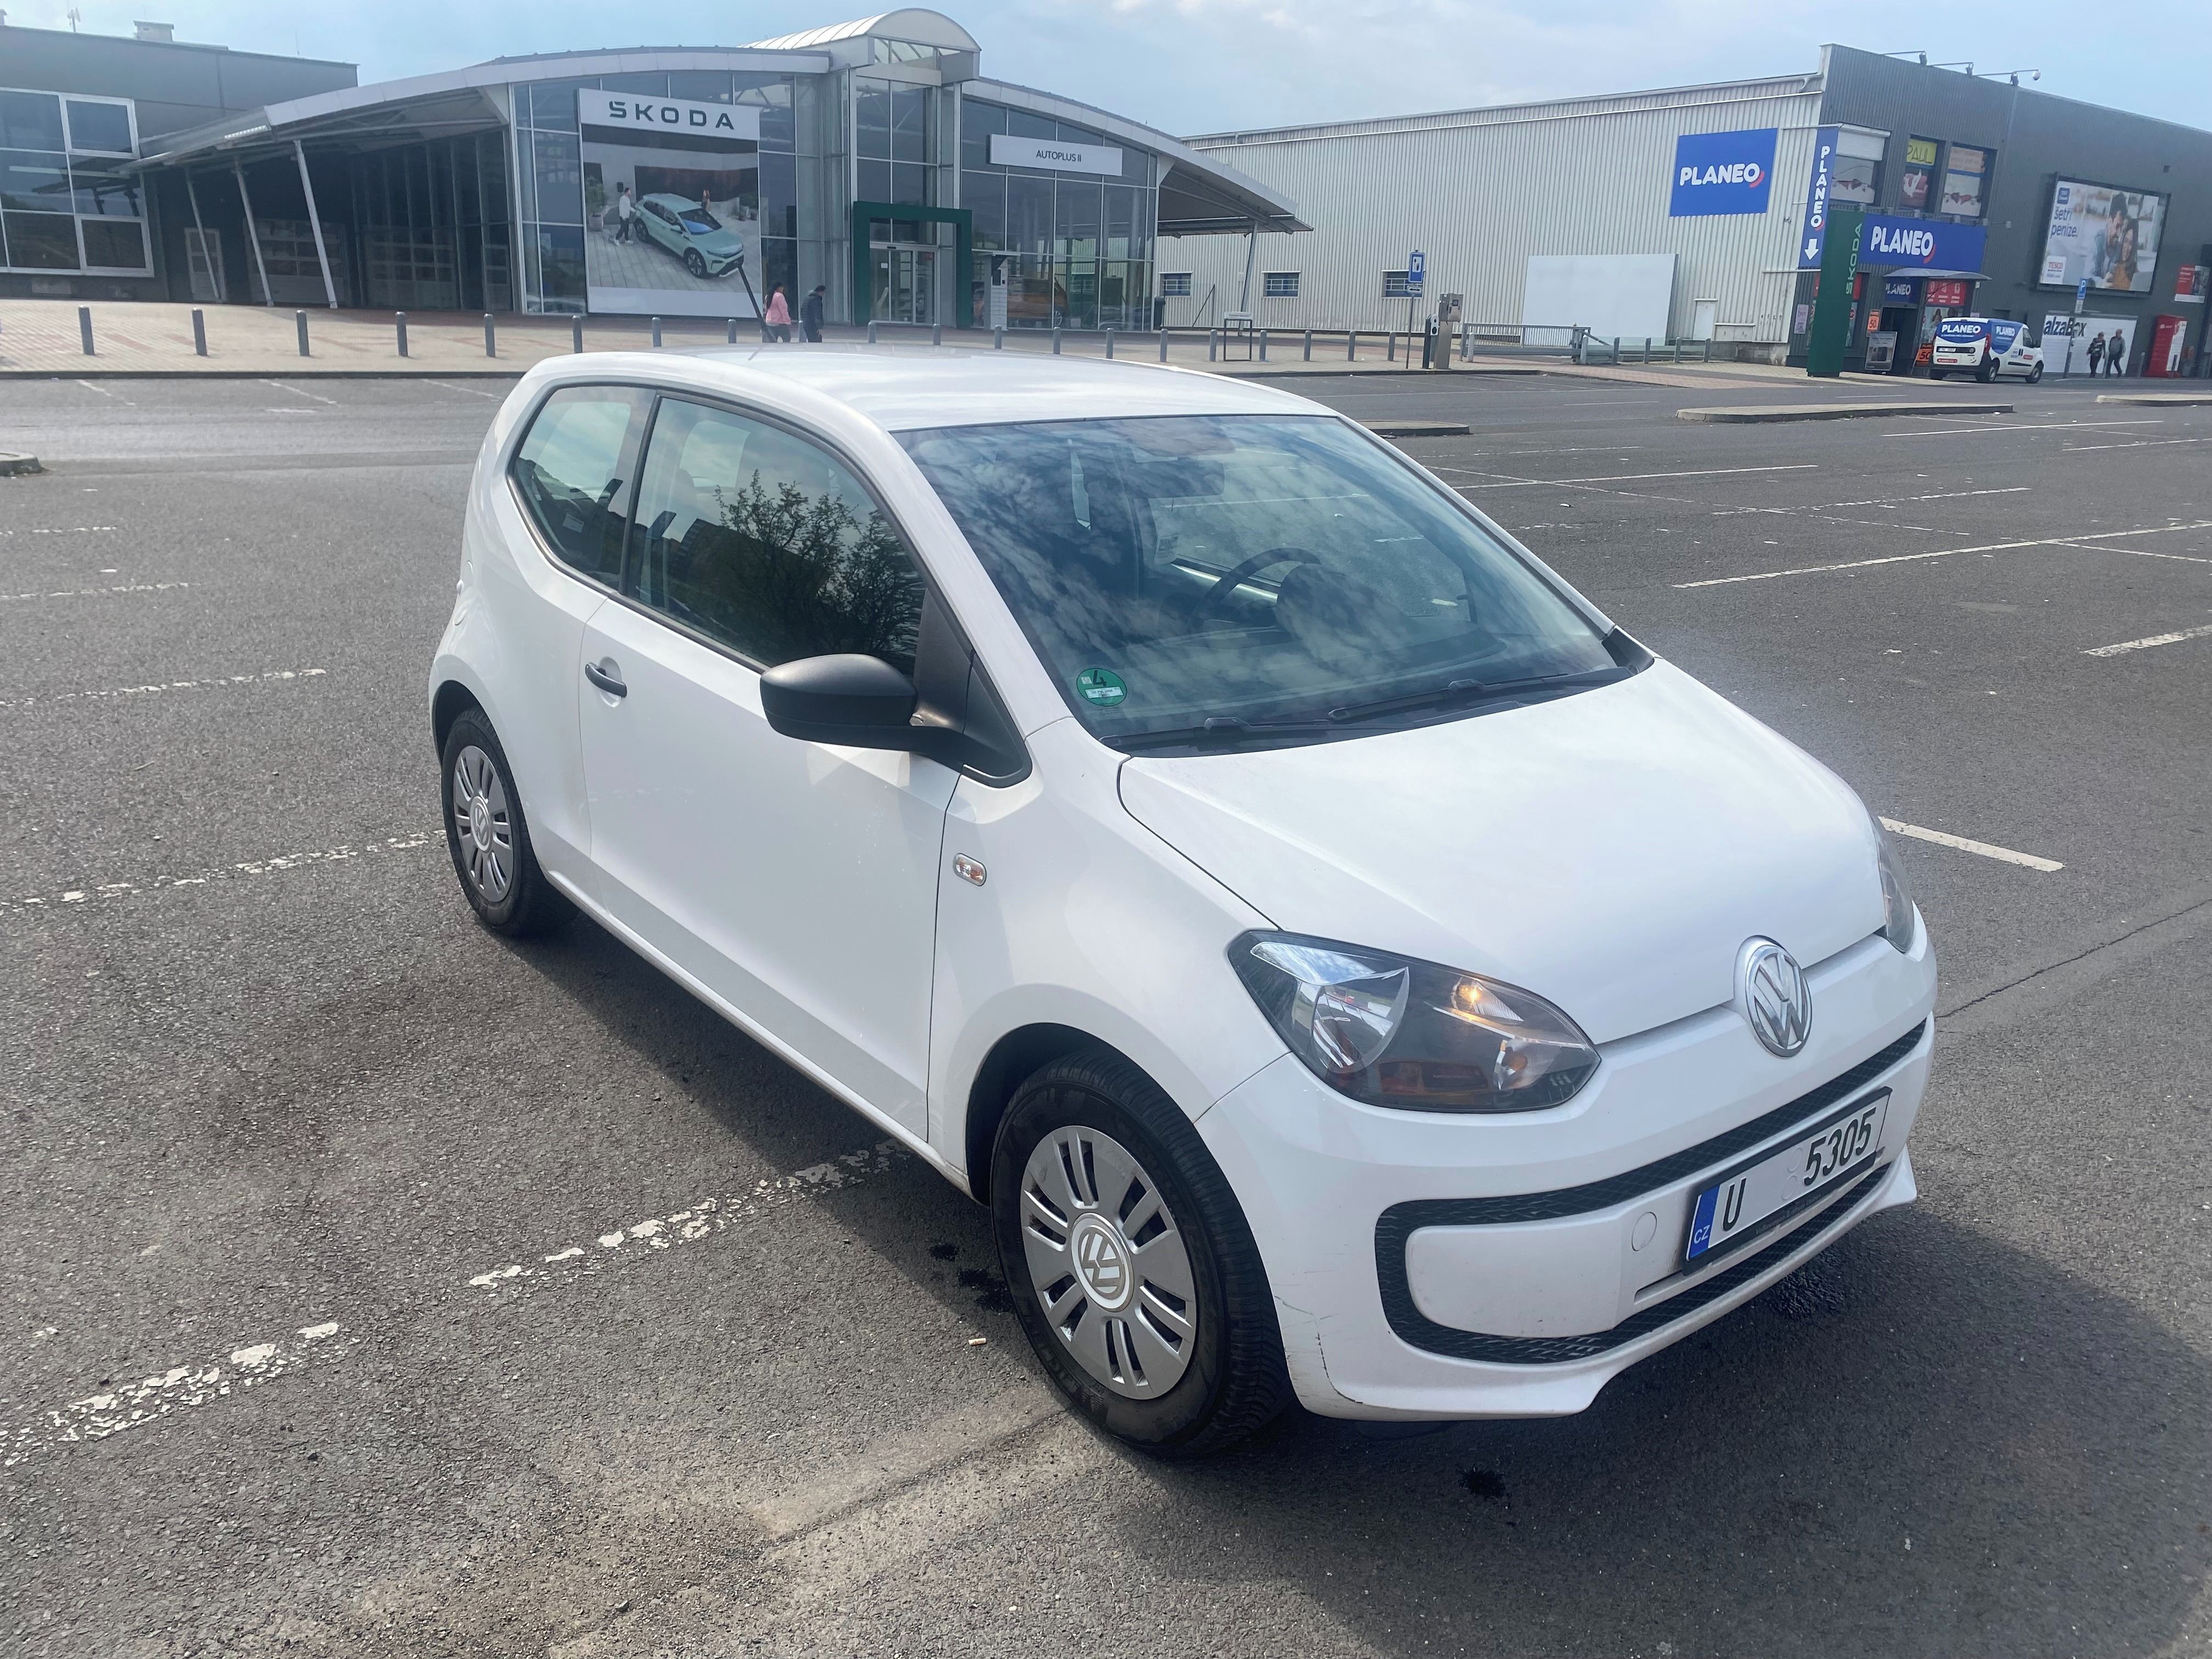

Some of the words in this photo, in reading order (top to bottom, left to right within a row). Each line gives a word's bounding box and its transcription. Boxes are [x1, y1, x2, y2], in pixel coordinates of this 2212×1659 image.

[1036, 150, 1076, 161] AUTOPLUS
[1680, 163, 1760, 186] PLANEO
[1810, 146, 1830, 228] PLANEO
[1871, 226, 1933, 256] PLANEO
[1942, 324, 1981, 334] PLANEO
[1996, 326, 2015, 336] PLANEO
[1092, 670, 1107, 686] 4
[1723, 1178, 1746, 1232] U
[1804, 1107, 1876, 1186] 5305
[1694, 1225, 1711, 1244] CZ
